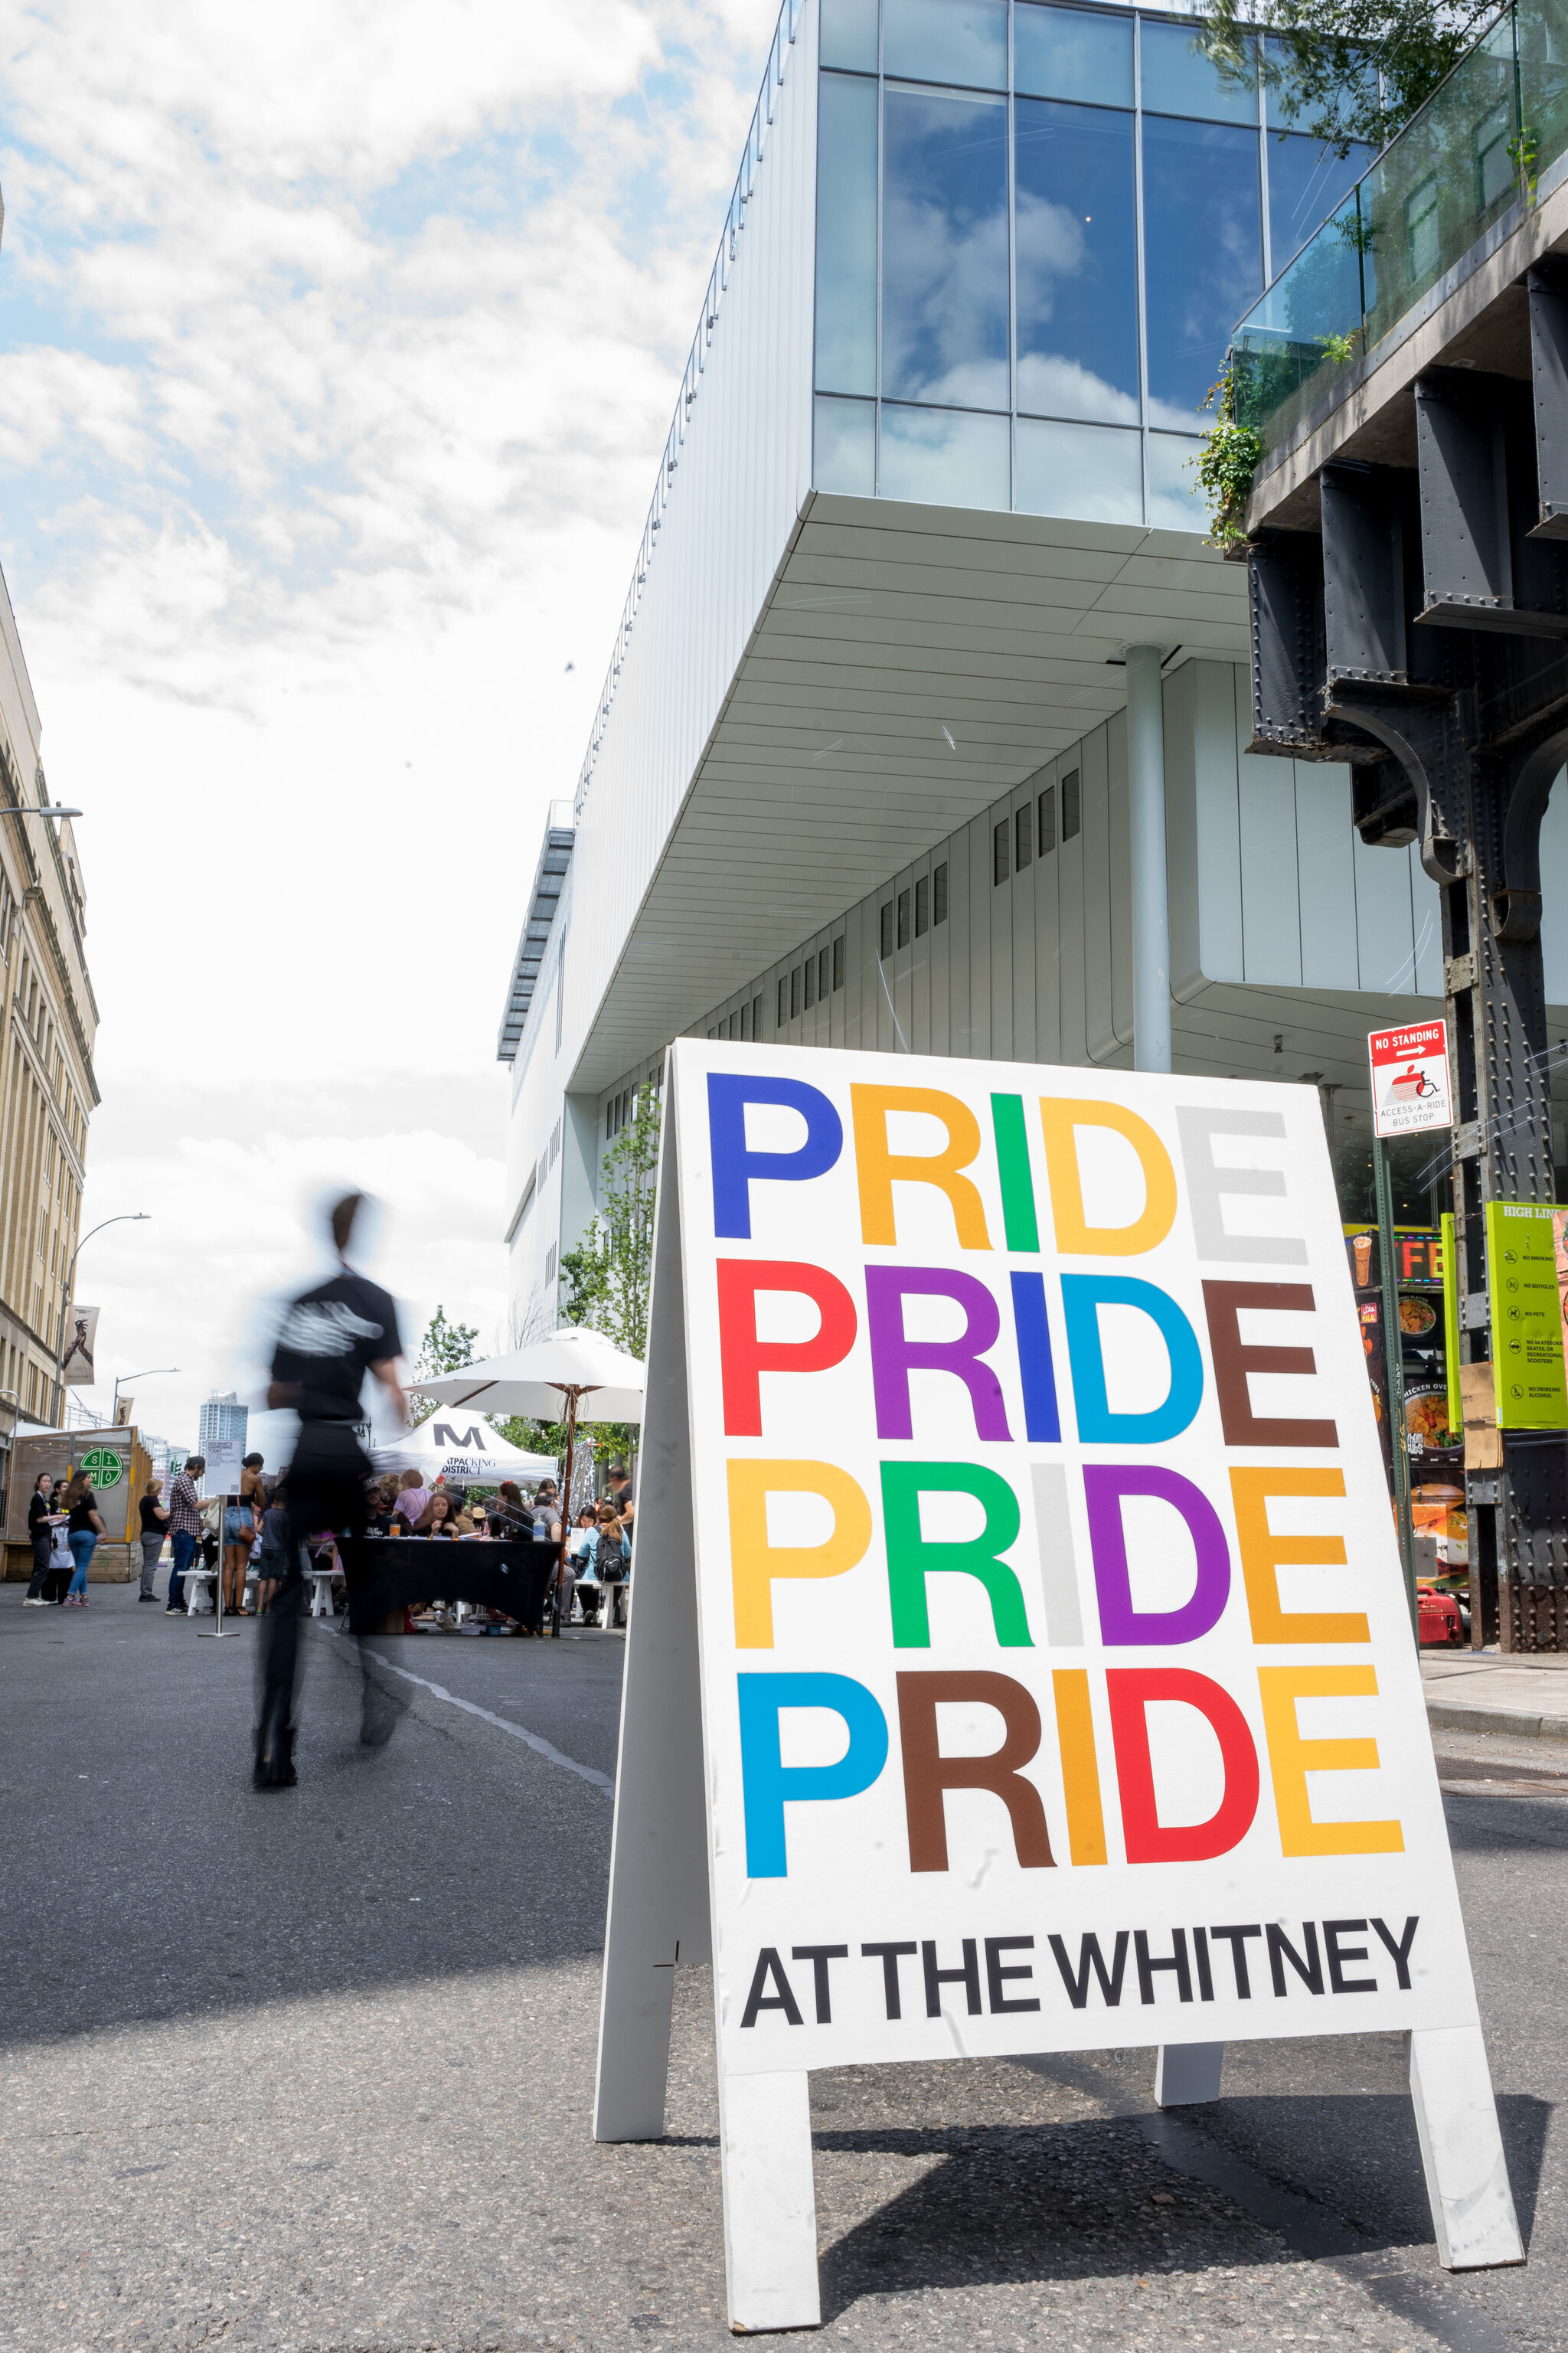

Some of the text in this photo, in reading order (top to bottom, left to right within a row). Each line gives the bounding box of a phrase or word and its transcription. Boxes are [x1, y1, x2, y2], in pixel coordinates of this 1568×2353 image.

[1376, 1028, 1439, 1050] NO STANDING
[1380, 1100, 1446, 1117] ACCESS-A-RIDE
[1393, 1113, 1435, 1126] BUS STOP
[706, 1072, 1309, 1266] PRIDE
[1503, 1206, 1534, 1218] HIGH
[1535, 1208, 1562, 1219] LIN
[1362, 1314, 1376, 1322] HALAL
[716, 1258, 1339, 1448] PRIDE
[1404, 1384, 1431, 1398] HICKEN
[433, 1423, 487, 1451] M
[726, 1458, 1372, 1649] PRIDE
[737, 1665, 1406, 1879] PRIDE
[740, 1916, 1419, 2028] AT THE WHITNEY
